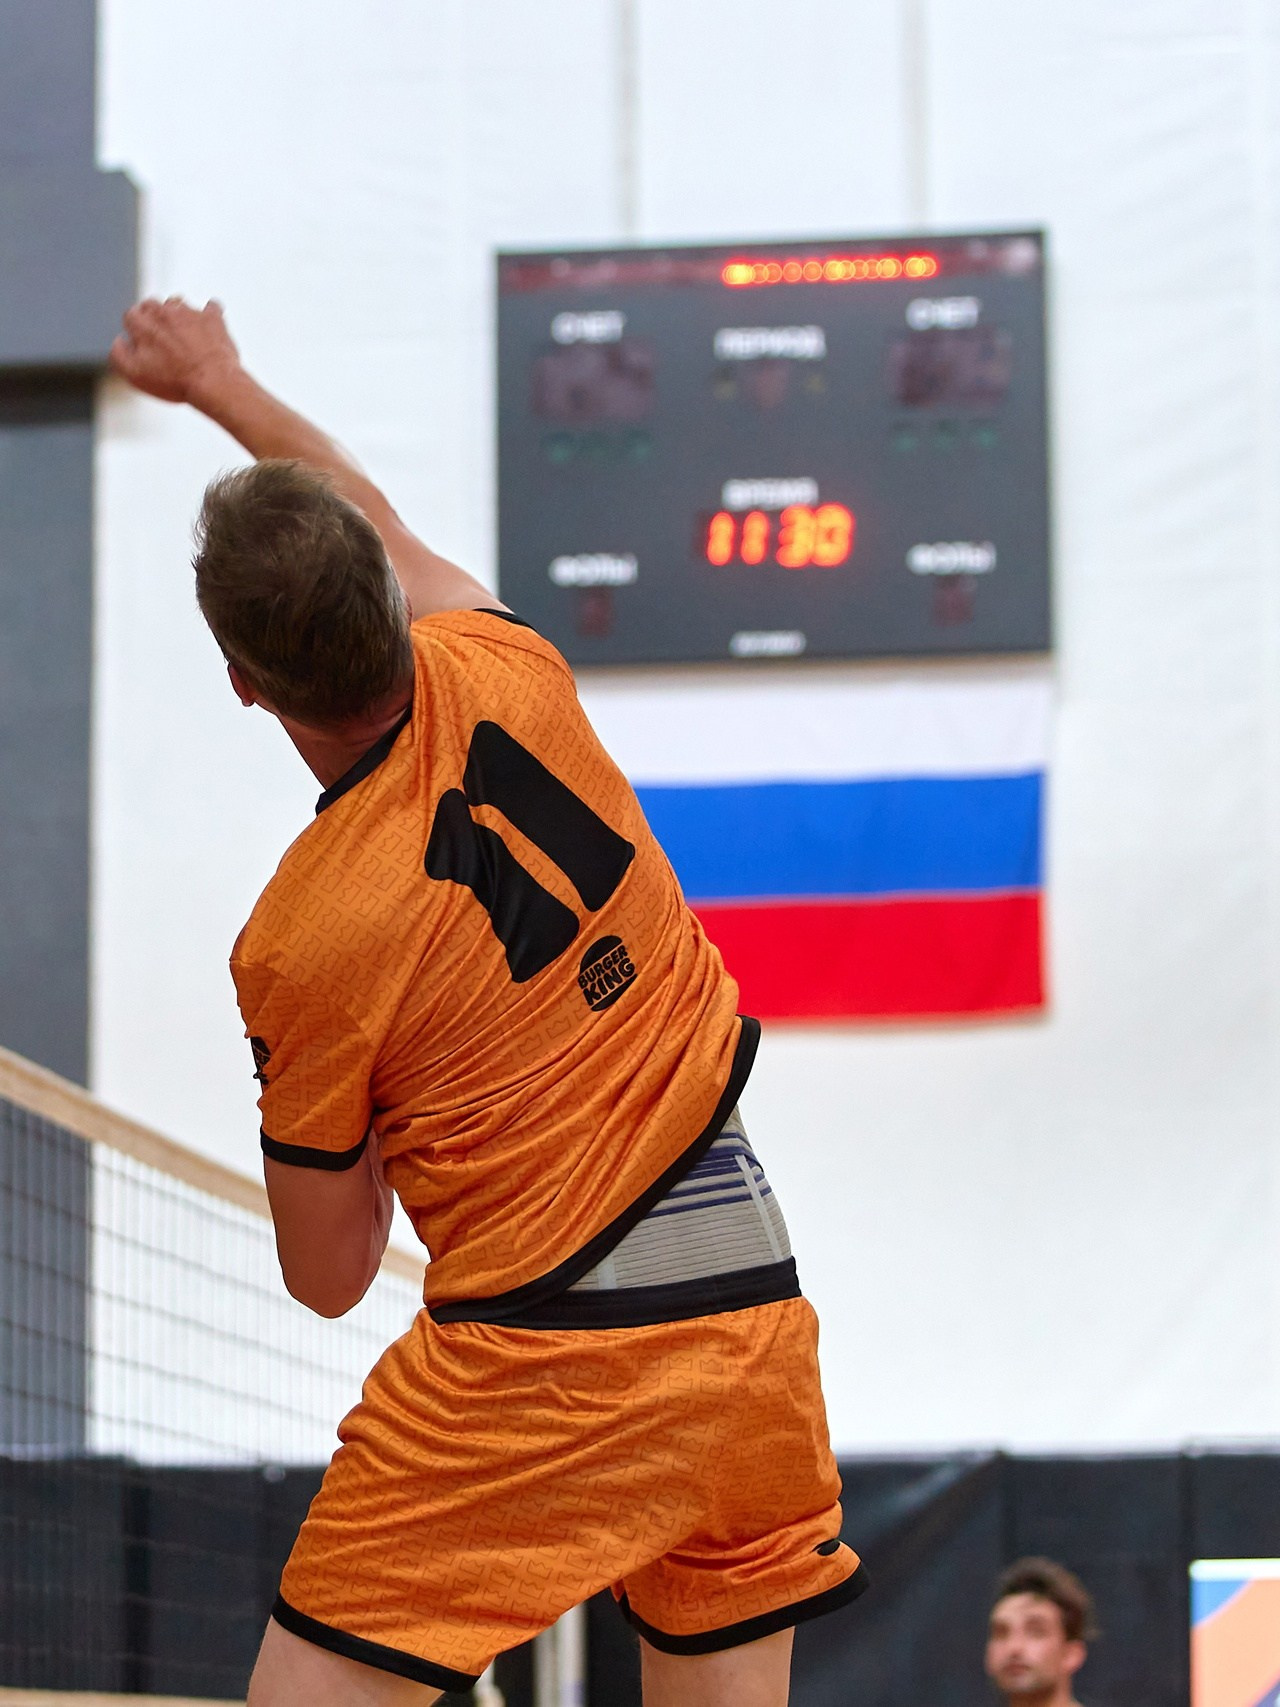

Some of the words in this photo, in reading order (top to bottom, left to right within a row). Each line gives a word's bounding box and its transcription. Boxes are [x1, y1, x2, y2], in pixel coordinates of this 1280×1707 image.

[424, 720, 636, 984] 11
[578, 944, 628, 989] BURGER
[583, 957, 635, 1006] KING
